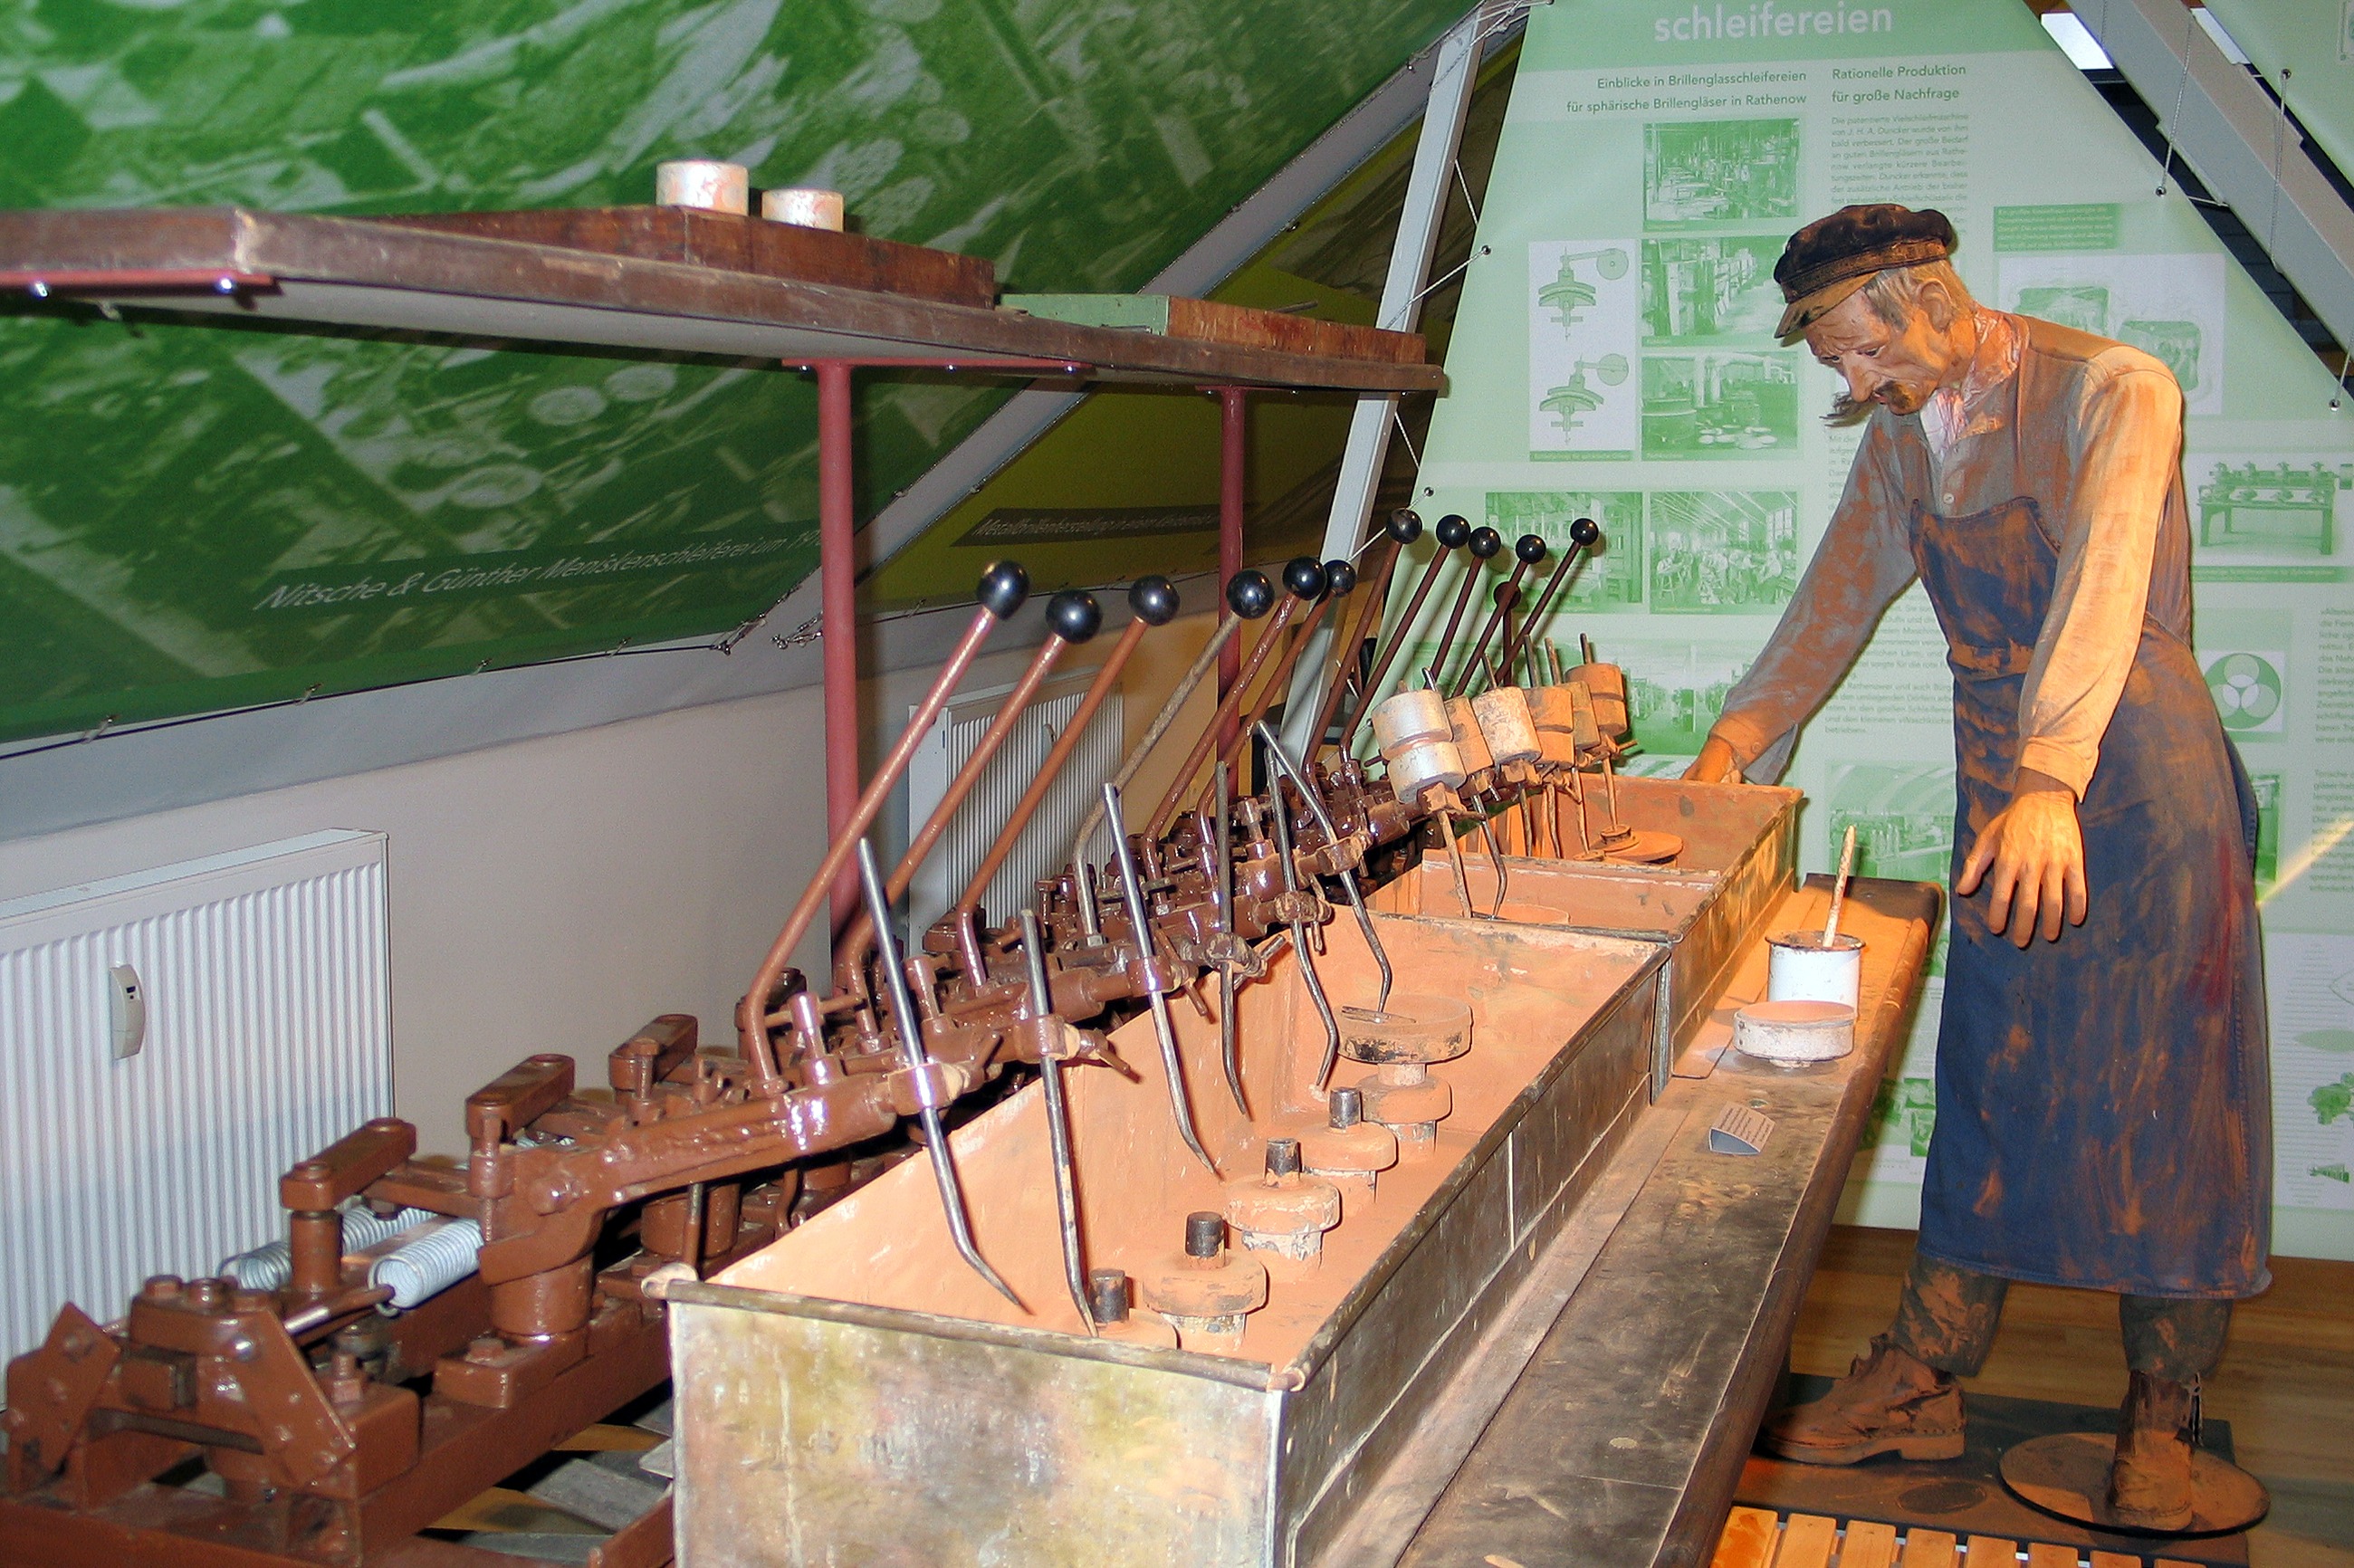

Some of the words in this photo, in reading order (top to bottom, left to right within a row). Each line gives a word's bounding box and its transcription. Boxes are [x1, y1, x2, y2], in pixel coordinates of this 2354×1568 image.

[1654, 2, 1893, 43] schleifereien
[1596, 77, 1651, 89] Einblicke
[1654, 76, 1664, 87] in
[1669, 71, 1807, 87] Brillenglasschleifereien
[1832, 66, 1893, 80] Rationelle
[1897, 64, 1966, 77] Produktion
[1566, 100, 1584, 112] für
[1587, 98, 1650, 114] sphärische
[1653, 96, 1727, 111] Brillengläser
[1731, 95, 1741, 106] in
[1746, 93, 1807, 106] Rathenow
[1832, 90, 1849, 102] für
[1852, 89, 1890, 105] große
[1894, 87, 1960, 101] Nachfrage
[253, 576, 388, 611] Nitsche
[388, 571, 425, 598] &
[422, 560, 543, 593] Günther
[536, 535, 765, 580] Meniskenschleiferei
